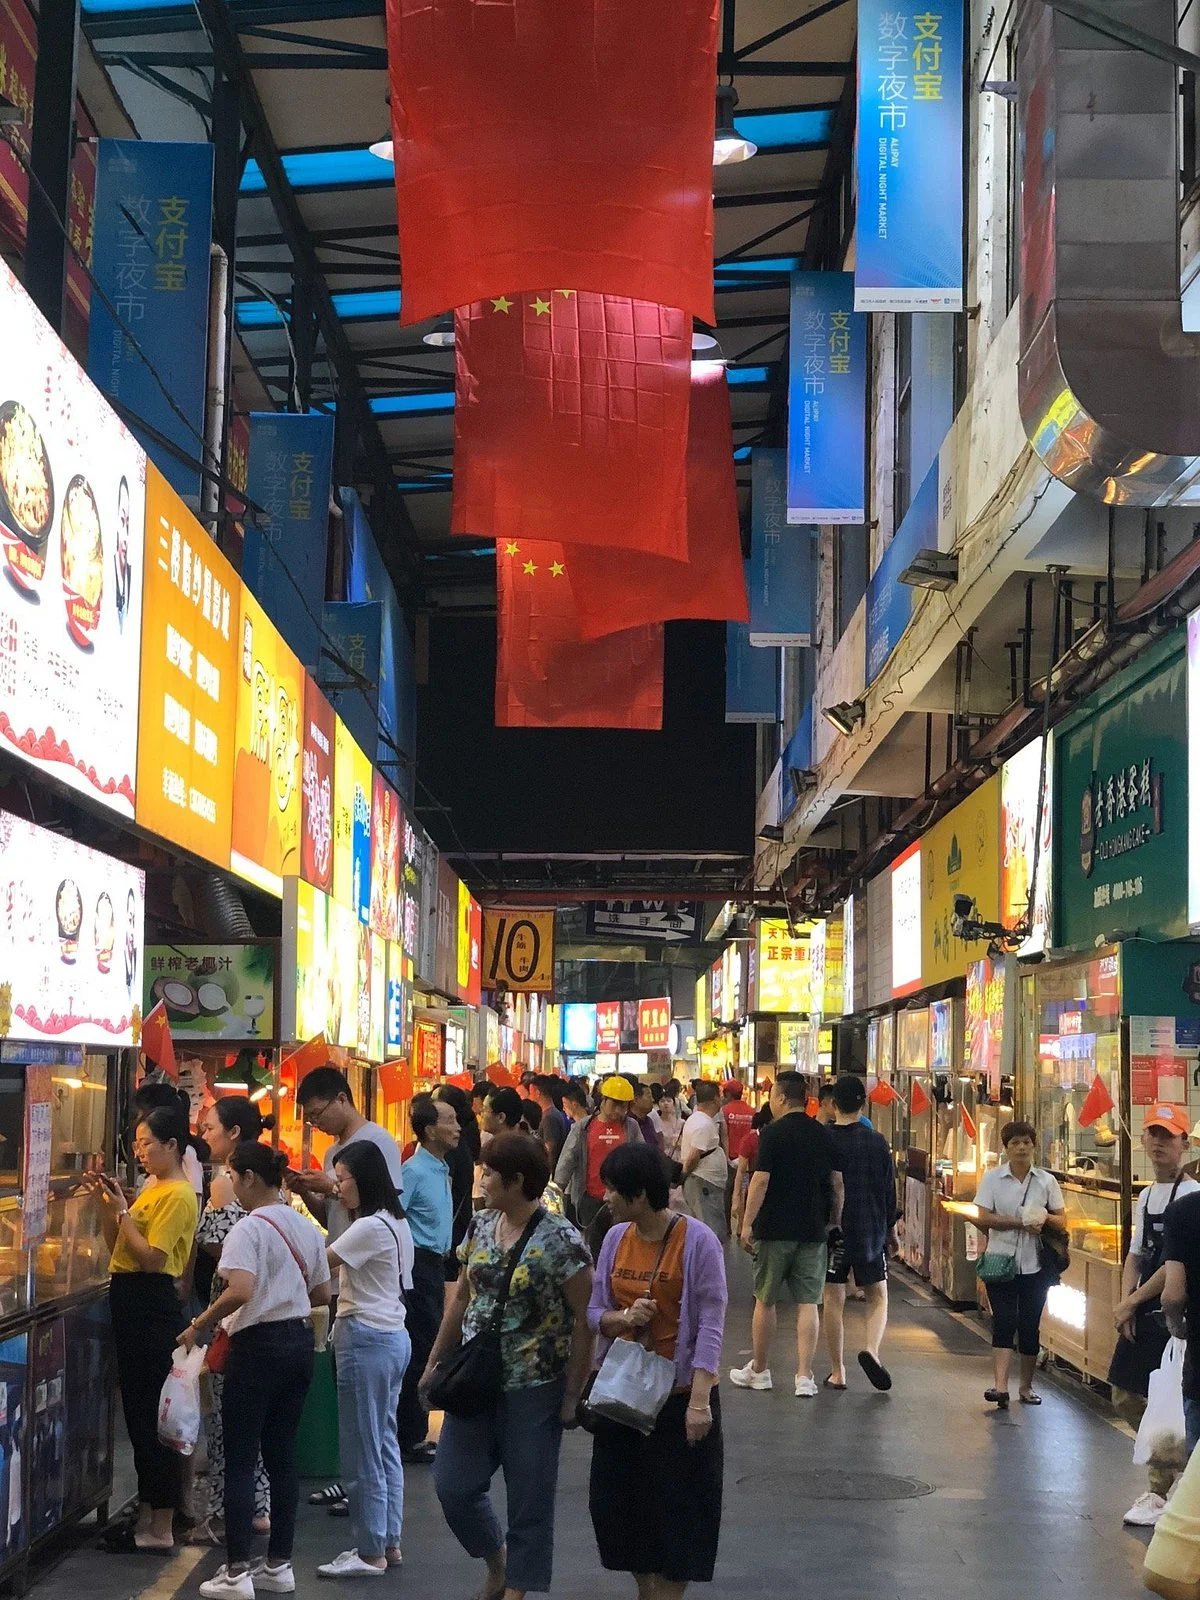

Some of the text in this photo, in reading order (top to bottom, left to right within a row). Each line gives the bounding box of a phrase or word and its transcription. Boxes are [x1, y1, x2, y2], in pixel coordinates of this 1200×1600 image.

[878, 12, 908, 131] 数字夜市
[912, 12, 943, 100] 支付宝
[891, 137, 900, 168] ALIPAY
[878, 137, 887, 240] DIGITAL NIGHT MARKET
[114, 193, 153, 323] 数字夜市
[152, 196, 190, 291] 支付宝
[803, 310, 826, 396] 数字夜市
[829, 309, 851, 374] 支付宝
[289, 452, 314, 520] 支付宝
[763, 479, 781, 545] 数字夜市
[1095, 757, 1151, 828] 老香港蛋糕
[150, 956, 233, 972] 鲜榨老椰汁
[489, 918, 540, 983] 10
[768, 945, 811, 961] 正宗重
[612, 1268, 670, 1282] BELIEE
